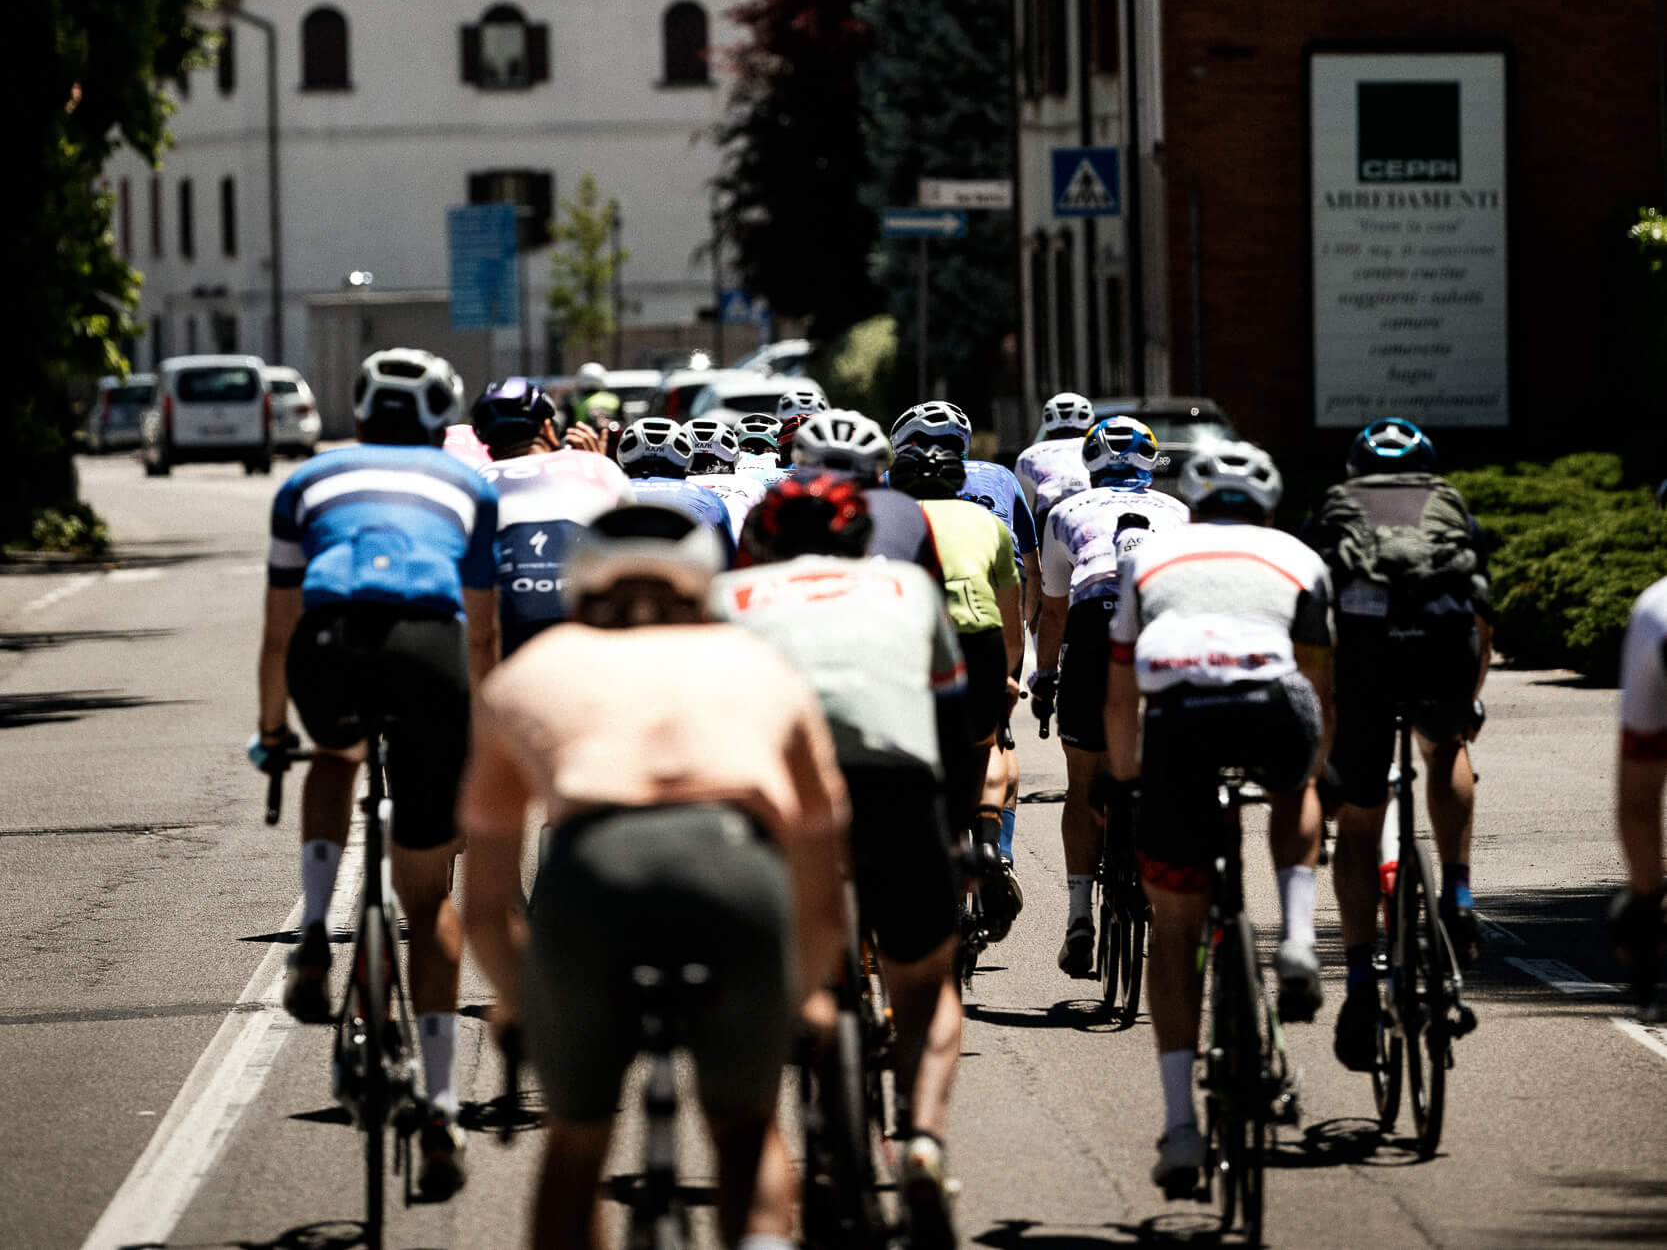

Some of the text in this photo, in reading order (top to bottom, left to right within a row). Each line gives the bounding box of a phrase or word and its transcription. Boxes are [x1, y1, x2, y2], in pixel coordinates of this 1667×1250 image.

[1362, 159, 1458, 179] CEPPI
[1325, 190, 1499, 209] ARREDAMENTI
[1386, 366, 1437, 385] bagni
